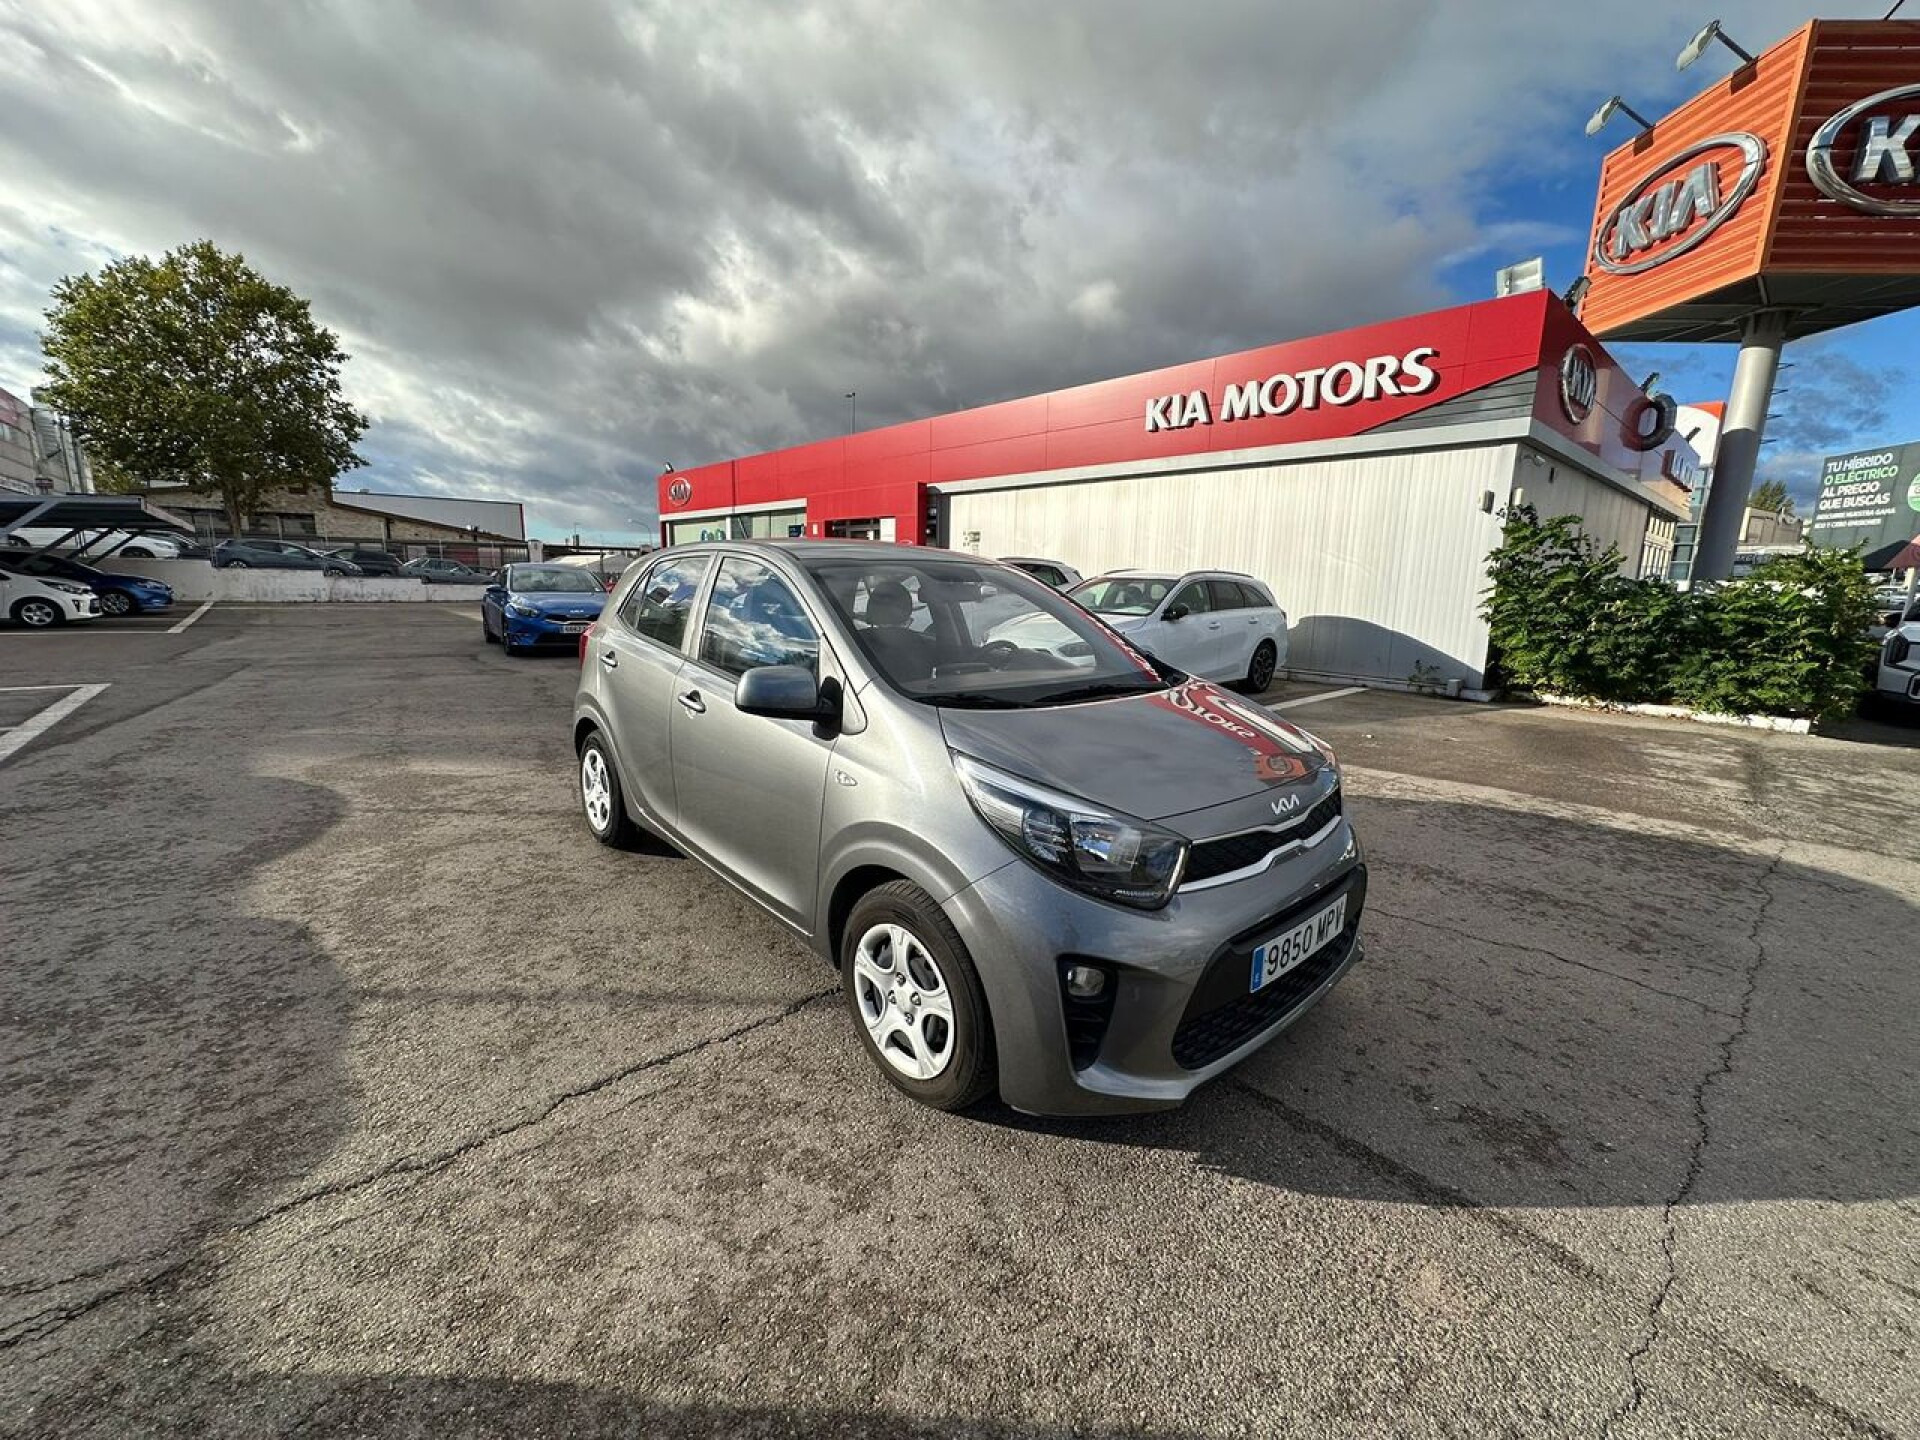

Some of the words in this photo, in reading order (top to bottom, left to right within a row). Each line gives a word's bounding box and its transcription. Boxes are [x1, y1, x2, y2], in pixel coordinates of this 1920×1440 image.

[1612, 162, 1722, 259] KIA
[1145, 389, 1211, 432] KIA
[1220, 347, 1439, 422] MOTORS
[1827, 460, 1842, 473] TU
[1842, 453, 1894, 471] HÍBRIDO
[1821, 486, 1836, 499] AL
[1837, 481, 1880, 496] PRECIO
[1823, 475, 1834, 485] O
[1819, 497, 1843, 511] QUE
[1842, 492, 1891, 508] BUSCAS
[1266, 923, 1313, 976] 9850
[1315, 903, 1344, 945] MPV
